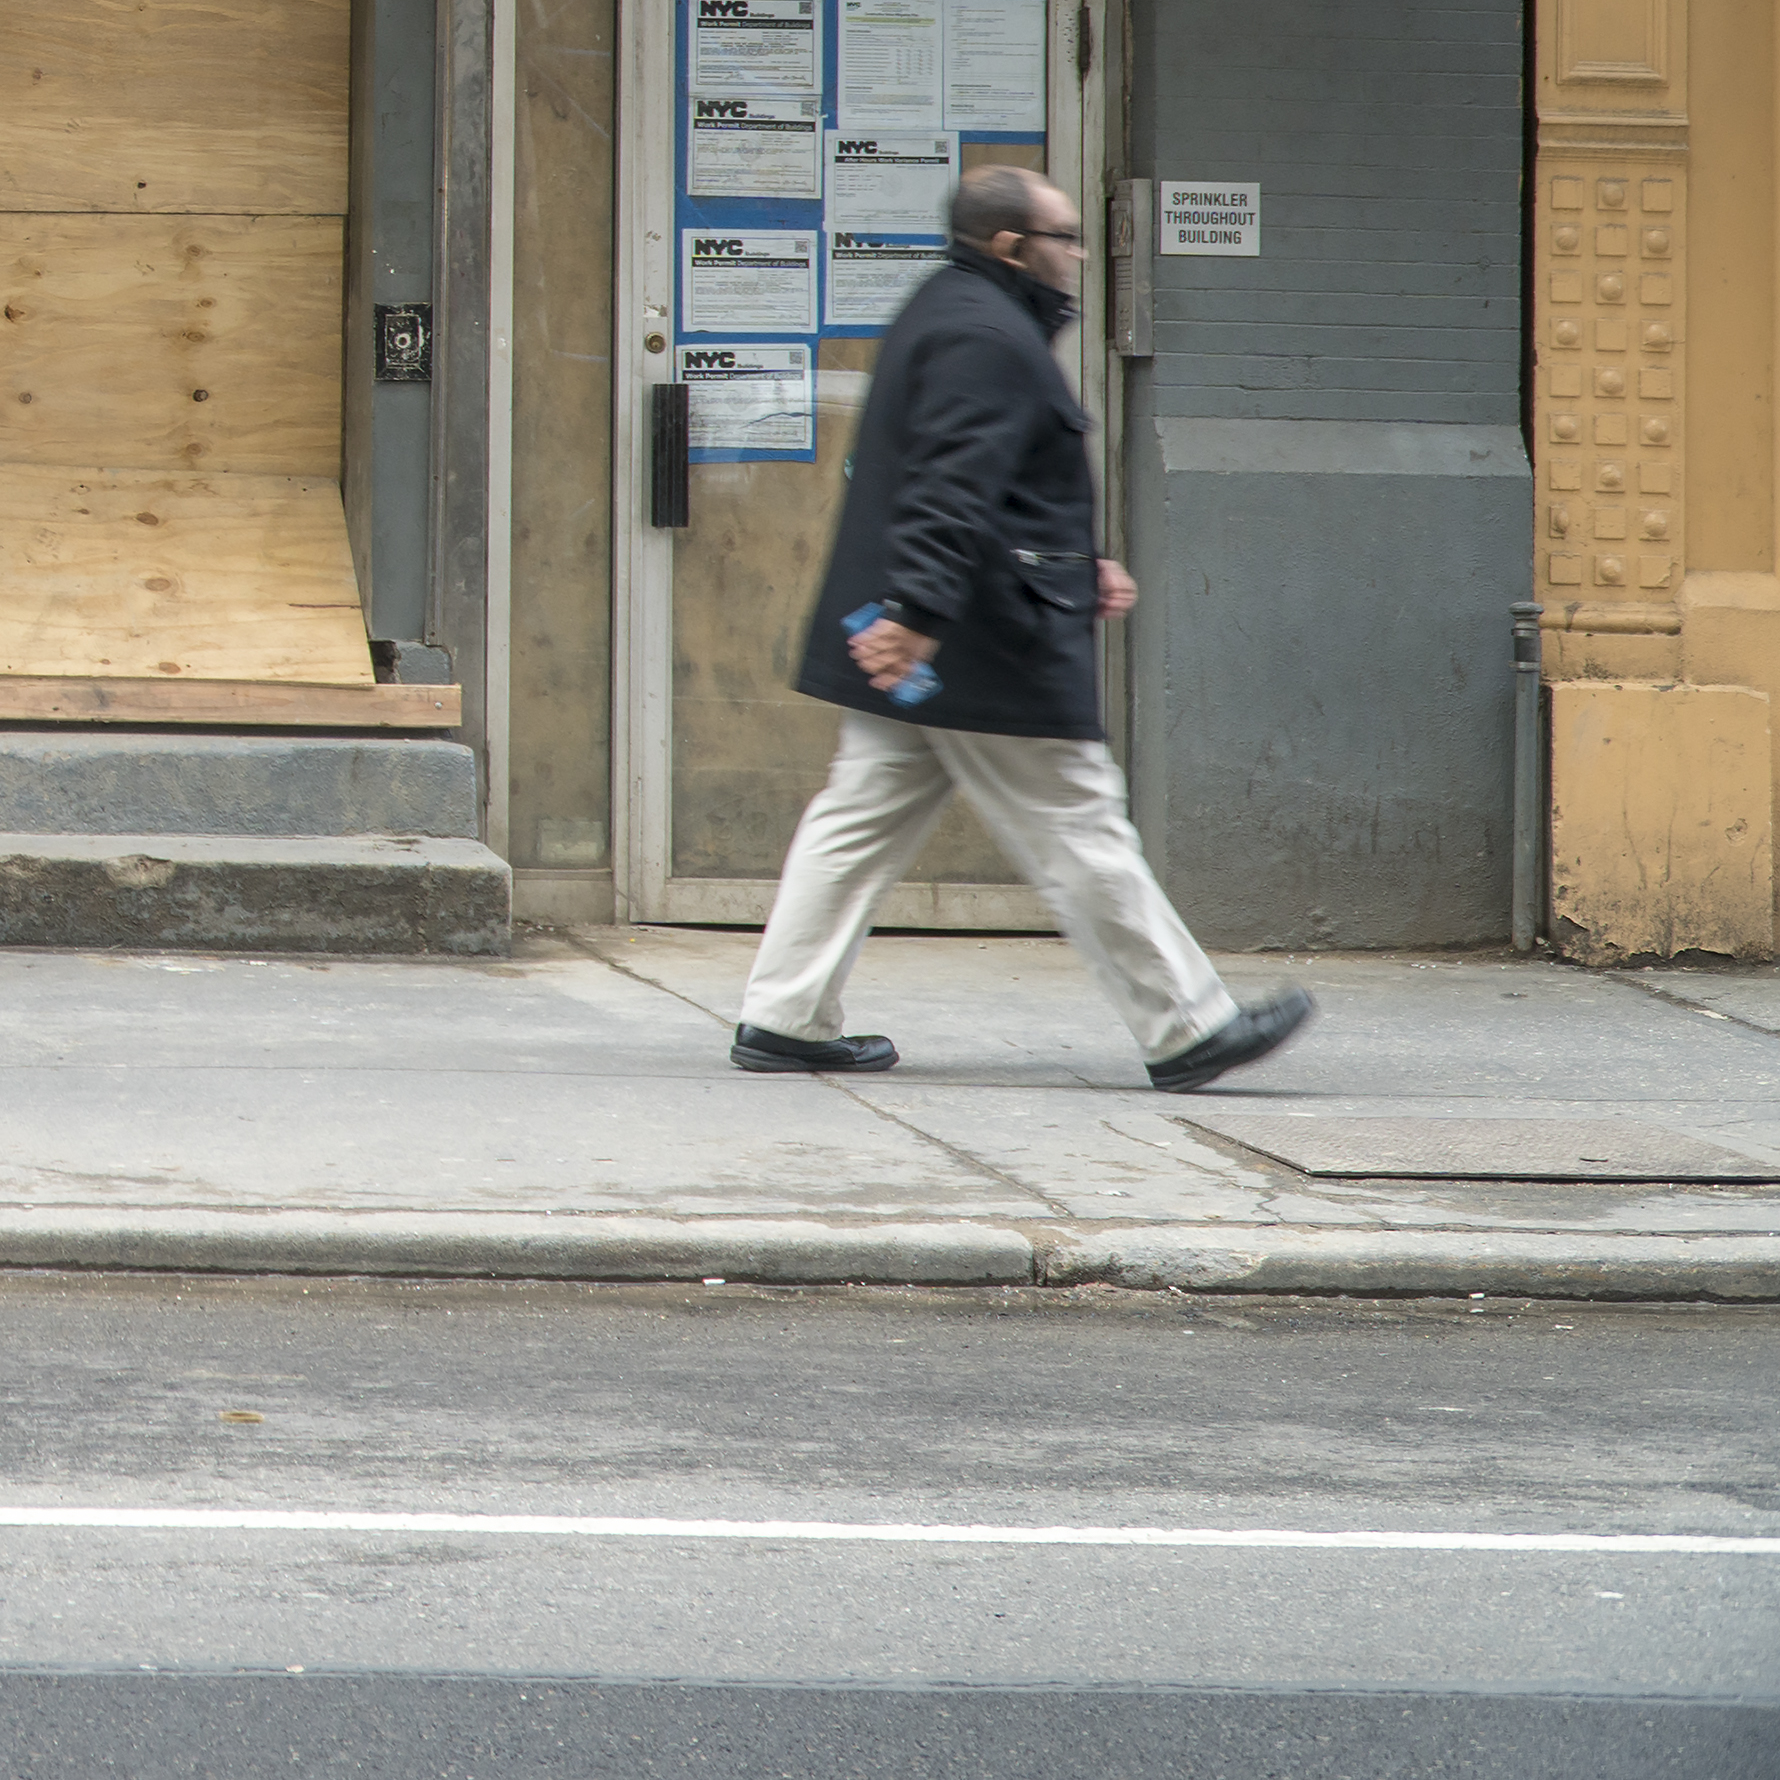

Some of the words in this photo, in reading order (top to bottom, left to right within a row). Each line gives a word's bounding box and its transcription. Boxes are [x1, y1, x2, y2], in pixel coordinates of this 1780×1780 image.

[700, 1, 748, 16] NYC
[697, 101, 747, 118] NYC
[838, 141, 877, 154] NYC
[1172, 192, 1248, 207] SPRINKLER
[1164, 211, 1256, 226] THROUGHOUT
[1178, 229, 1242, 244] BUILDING
[695, 239, 743, 255] NYC
[685, 352, 735, 368] NYC
